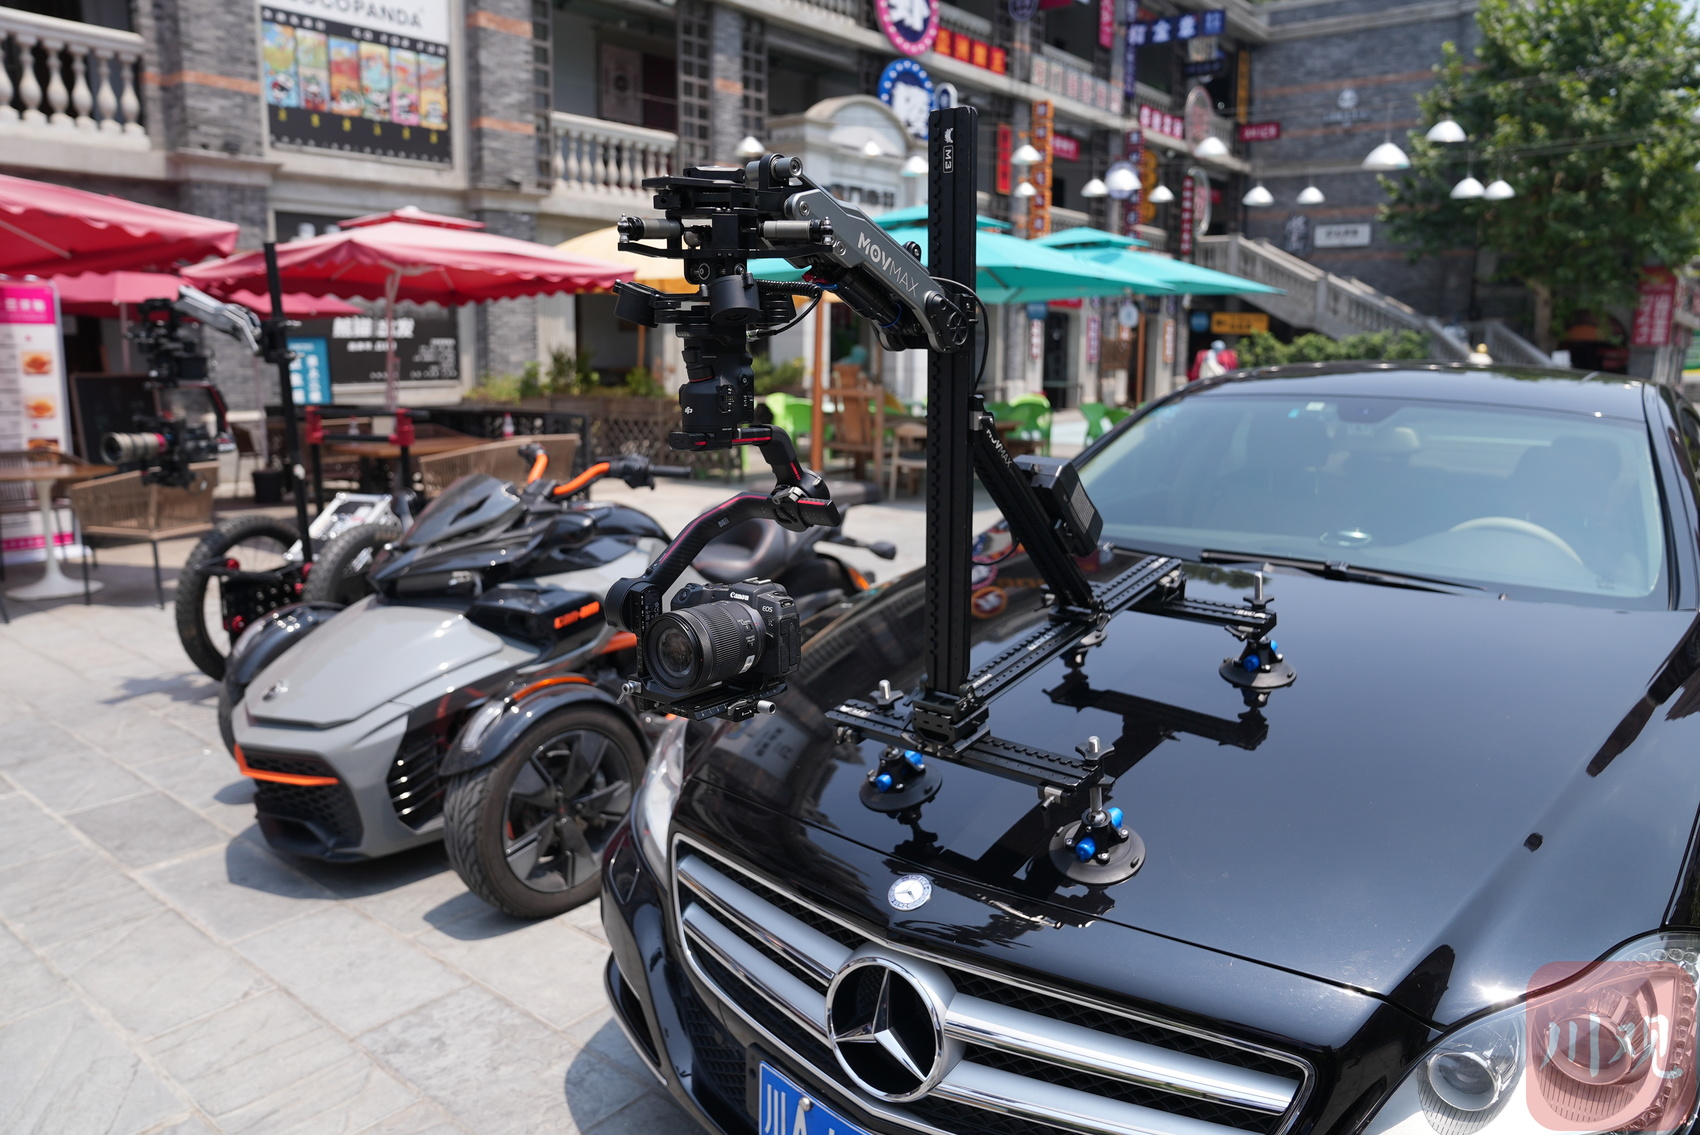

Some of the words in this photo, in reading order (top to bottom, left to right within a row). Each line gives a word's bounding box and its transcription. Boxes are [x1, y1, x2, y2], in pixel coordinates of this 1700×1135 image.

[944, 148, 952, 171] M3
[857, 231, 920, 298] MOVMAX
[729, 591, 750, 601] Canon
[762, 605, 773, 613] EOS
